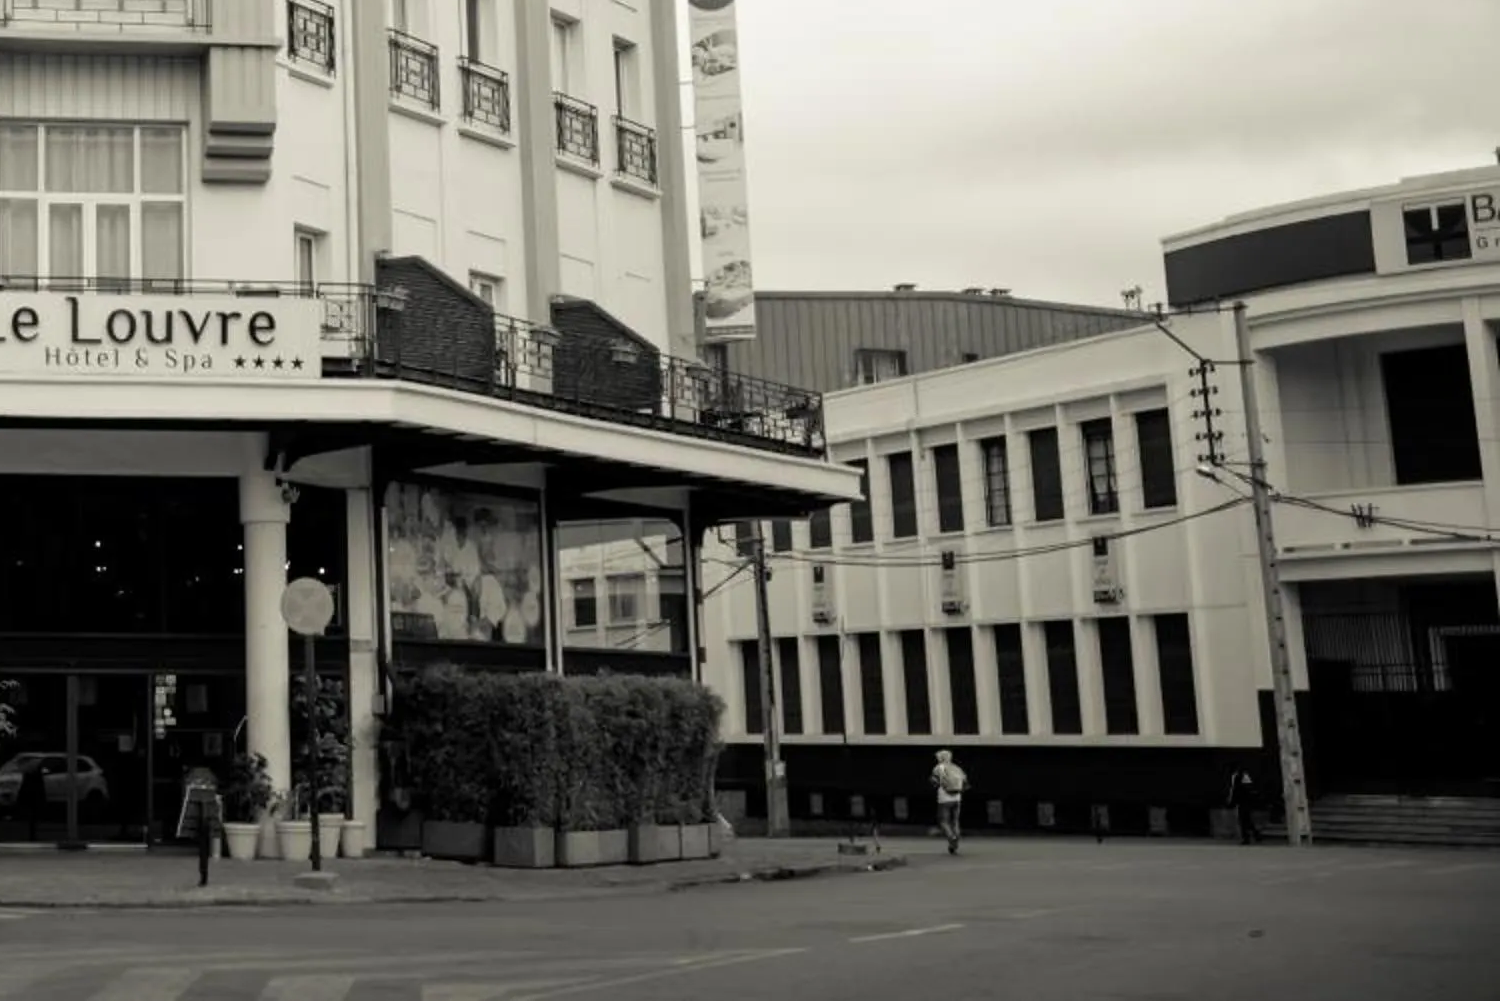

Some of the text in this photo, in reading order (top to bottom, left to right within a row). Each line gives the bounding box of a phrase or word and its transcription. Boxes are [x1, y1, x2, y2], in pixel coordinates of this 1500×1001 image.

[1472, 194, 1500, 223] B
[65, 296, 277, 347] Louvre
[44, 346, 213, 372] Hôtel & Spa
